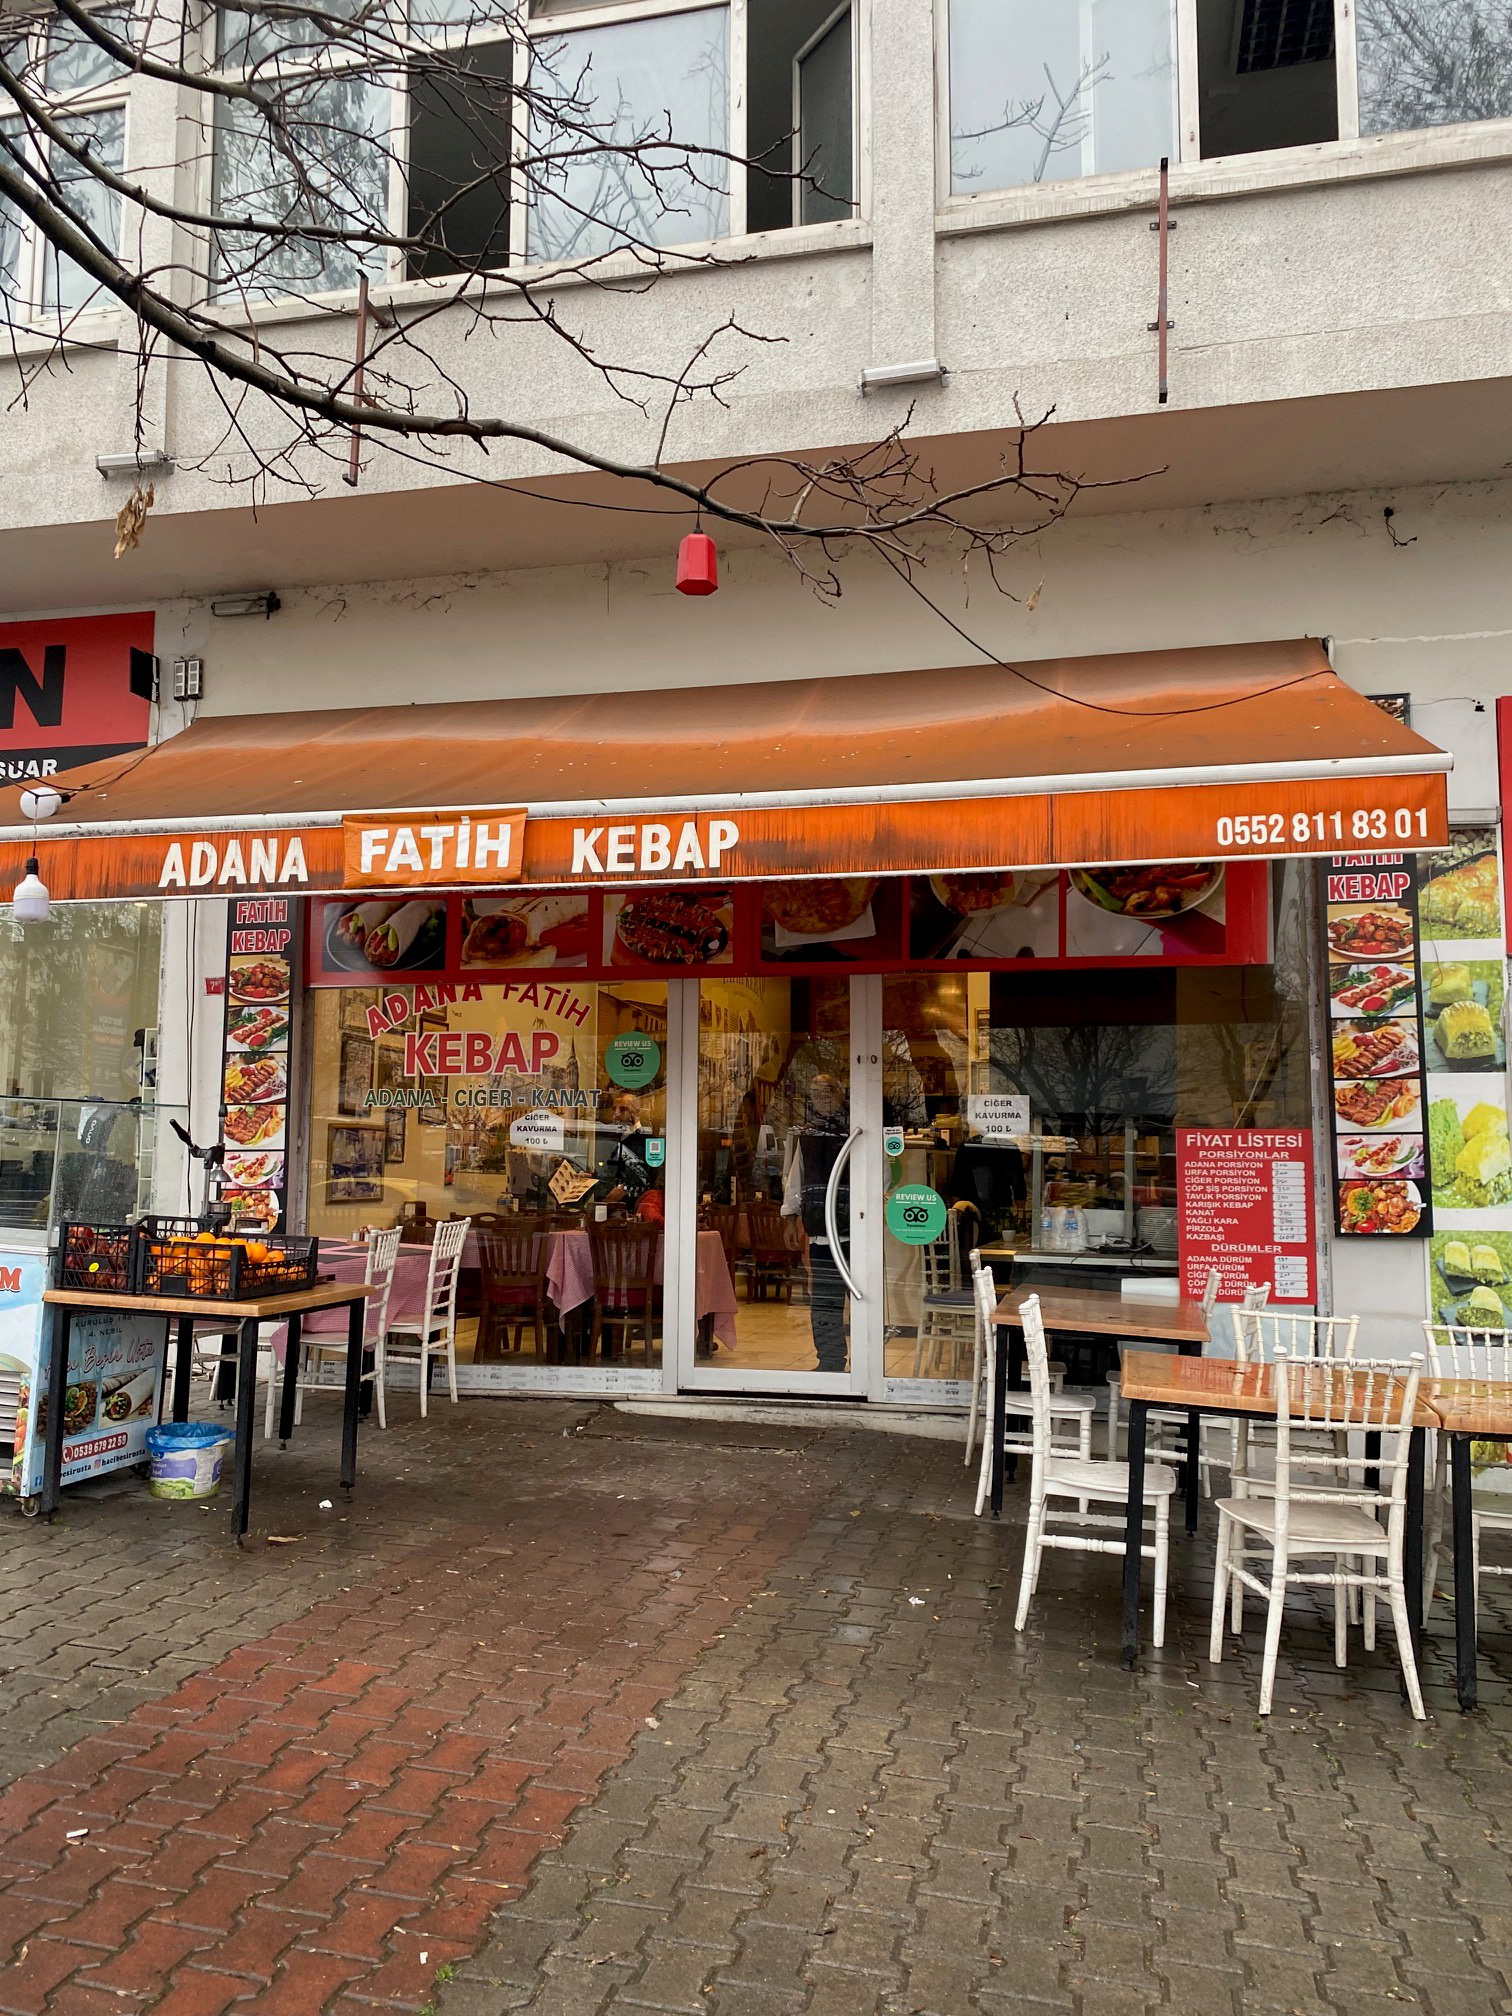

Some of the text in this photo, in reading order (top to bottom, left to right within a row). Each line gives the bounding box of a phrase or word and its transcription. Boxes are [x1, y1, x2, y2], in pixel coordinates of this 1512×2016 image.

[1216, 807, 1428, 846] 0552 811 83 01
[158, 815, 740, 888] ADANA FATİH KEBAP
[1327, 872, 1411, 902] KEBAP
[236, 897, 288, 924] FATİH
[231, 928, 292, 954] KEBAP
[366, 982, 592, 1041] ADANA FATİH
[404, 1030, 560, 1077] KEBAP
[363, 1088, 435, 1108] ADANA
[454, 1085, 513, 1108] CİĞER
[531, 1088, 602, 1108] KANAT
[983, 1099, 1012, 1107] CİĞER
[525, 1113, 550, 1121] CİĞER
[525, 1137, 541, 1145] 100
[1186, 1132, 1303, 1148] FİYAT LİSTESİ
[1198, 1149, 1290, 1159] PORSİYONLAR
[1217, 1160, 1264, 1169] PORSİYON
[1184, 1168, 1209, 1176] URFA
[1210, 1168, 1256, 1176] PORSİYON
[1184, 1176, 1212, 1184] CİĞER
[1214, 1176, 1260, 1185] PORSİYON
[1185, 1184, 1204, 1193] ÇÖP
[1205, 1184, 1220, 1193] ŞİŞ
[1221, 1184, 1268, 1193] PORSİYON
[895, 1193, 937, 1202] REVIEW US
[1216, 1192, 1262, 1201] PORSİYON
[1185, 1201, 1221, 1209] KARIŞIK
[1223, 1201, 1254, 1209] KEBAP
[1213, 1217, 1239, 1225] KARA
[1186, 1225, 1224, 1233] PİRZOLA
[1186, 1233, 1225, 1241] KAZBAŞI
[1211, 1243, 1282, 1253] DÜRÜMLER
[1187, 1255, 1219, 1263] ADANA
[1220, 1255, 1252, 1264] DÜRÜM
[1187, 1263, 1211, 1271] URFA
[1212, 1263, 1245, 1271] DÜRÜM
[1187, 1271, 1209, 1279] CİĞE
[1187, 1279, 1207, 1288] ÇÖP
[1224, 1280, 1257, 1288] DÜRÜM
[1218, 1288, 1246, 1296] DÜRÜ
[73, 1434, 127, 1458] 0539 679 22 59
[101, 1448, 146, 1467] hacibesirusta
